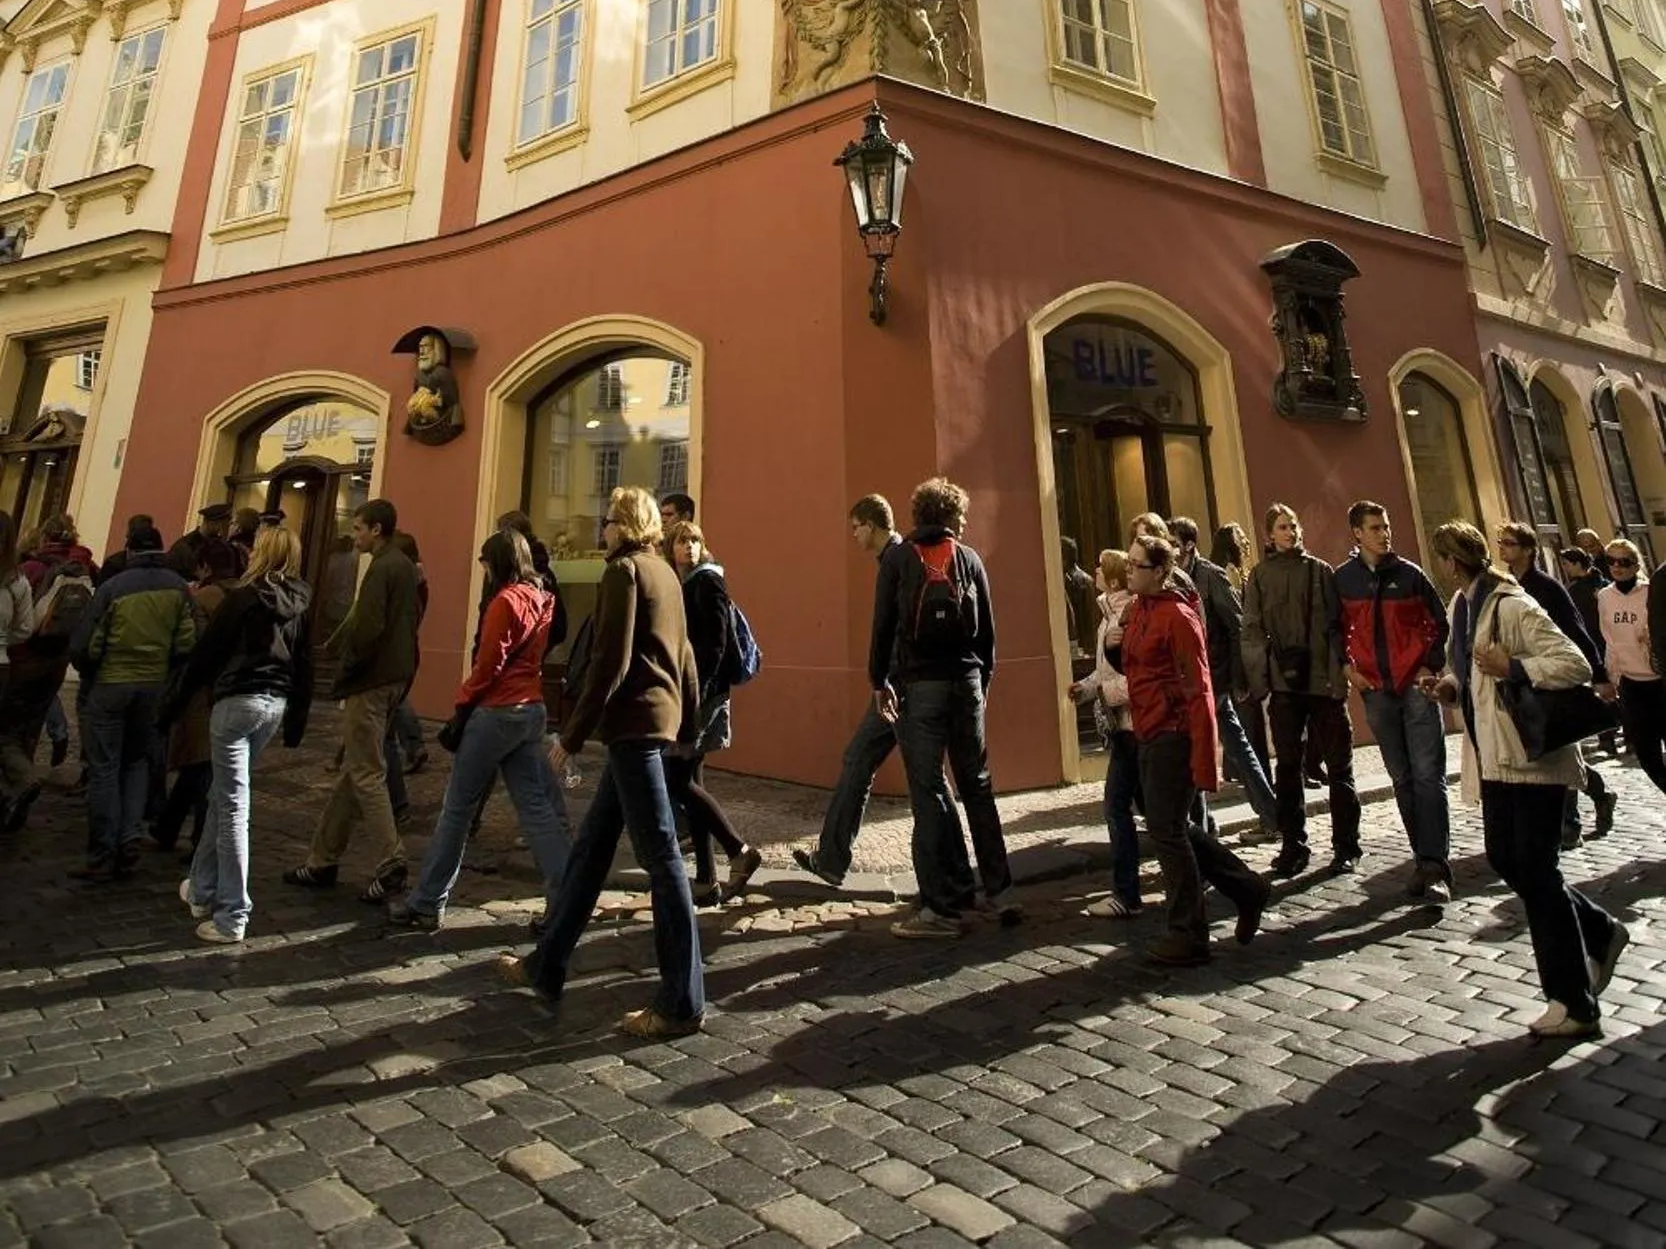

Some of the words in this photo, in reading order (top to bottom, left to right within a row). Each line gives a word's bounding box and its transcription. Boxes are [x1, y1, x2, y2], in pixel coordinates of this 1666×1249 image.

[1074, 338, 1159, 387] BLUE
[287, 409, 341, 442] BLUE
[1614, 611, 1638, 625] GAP
